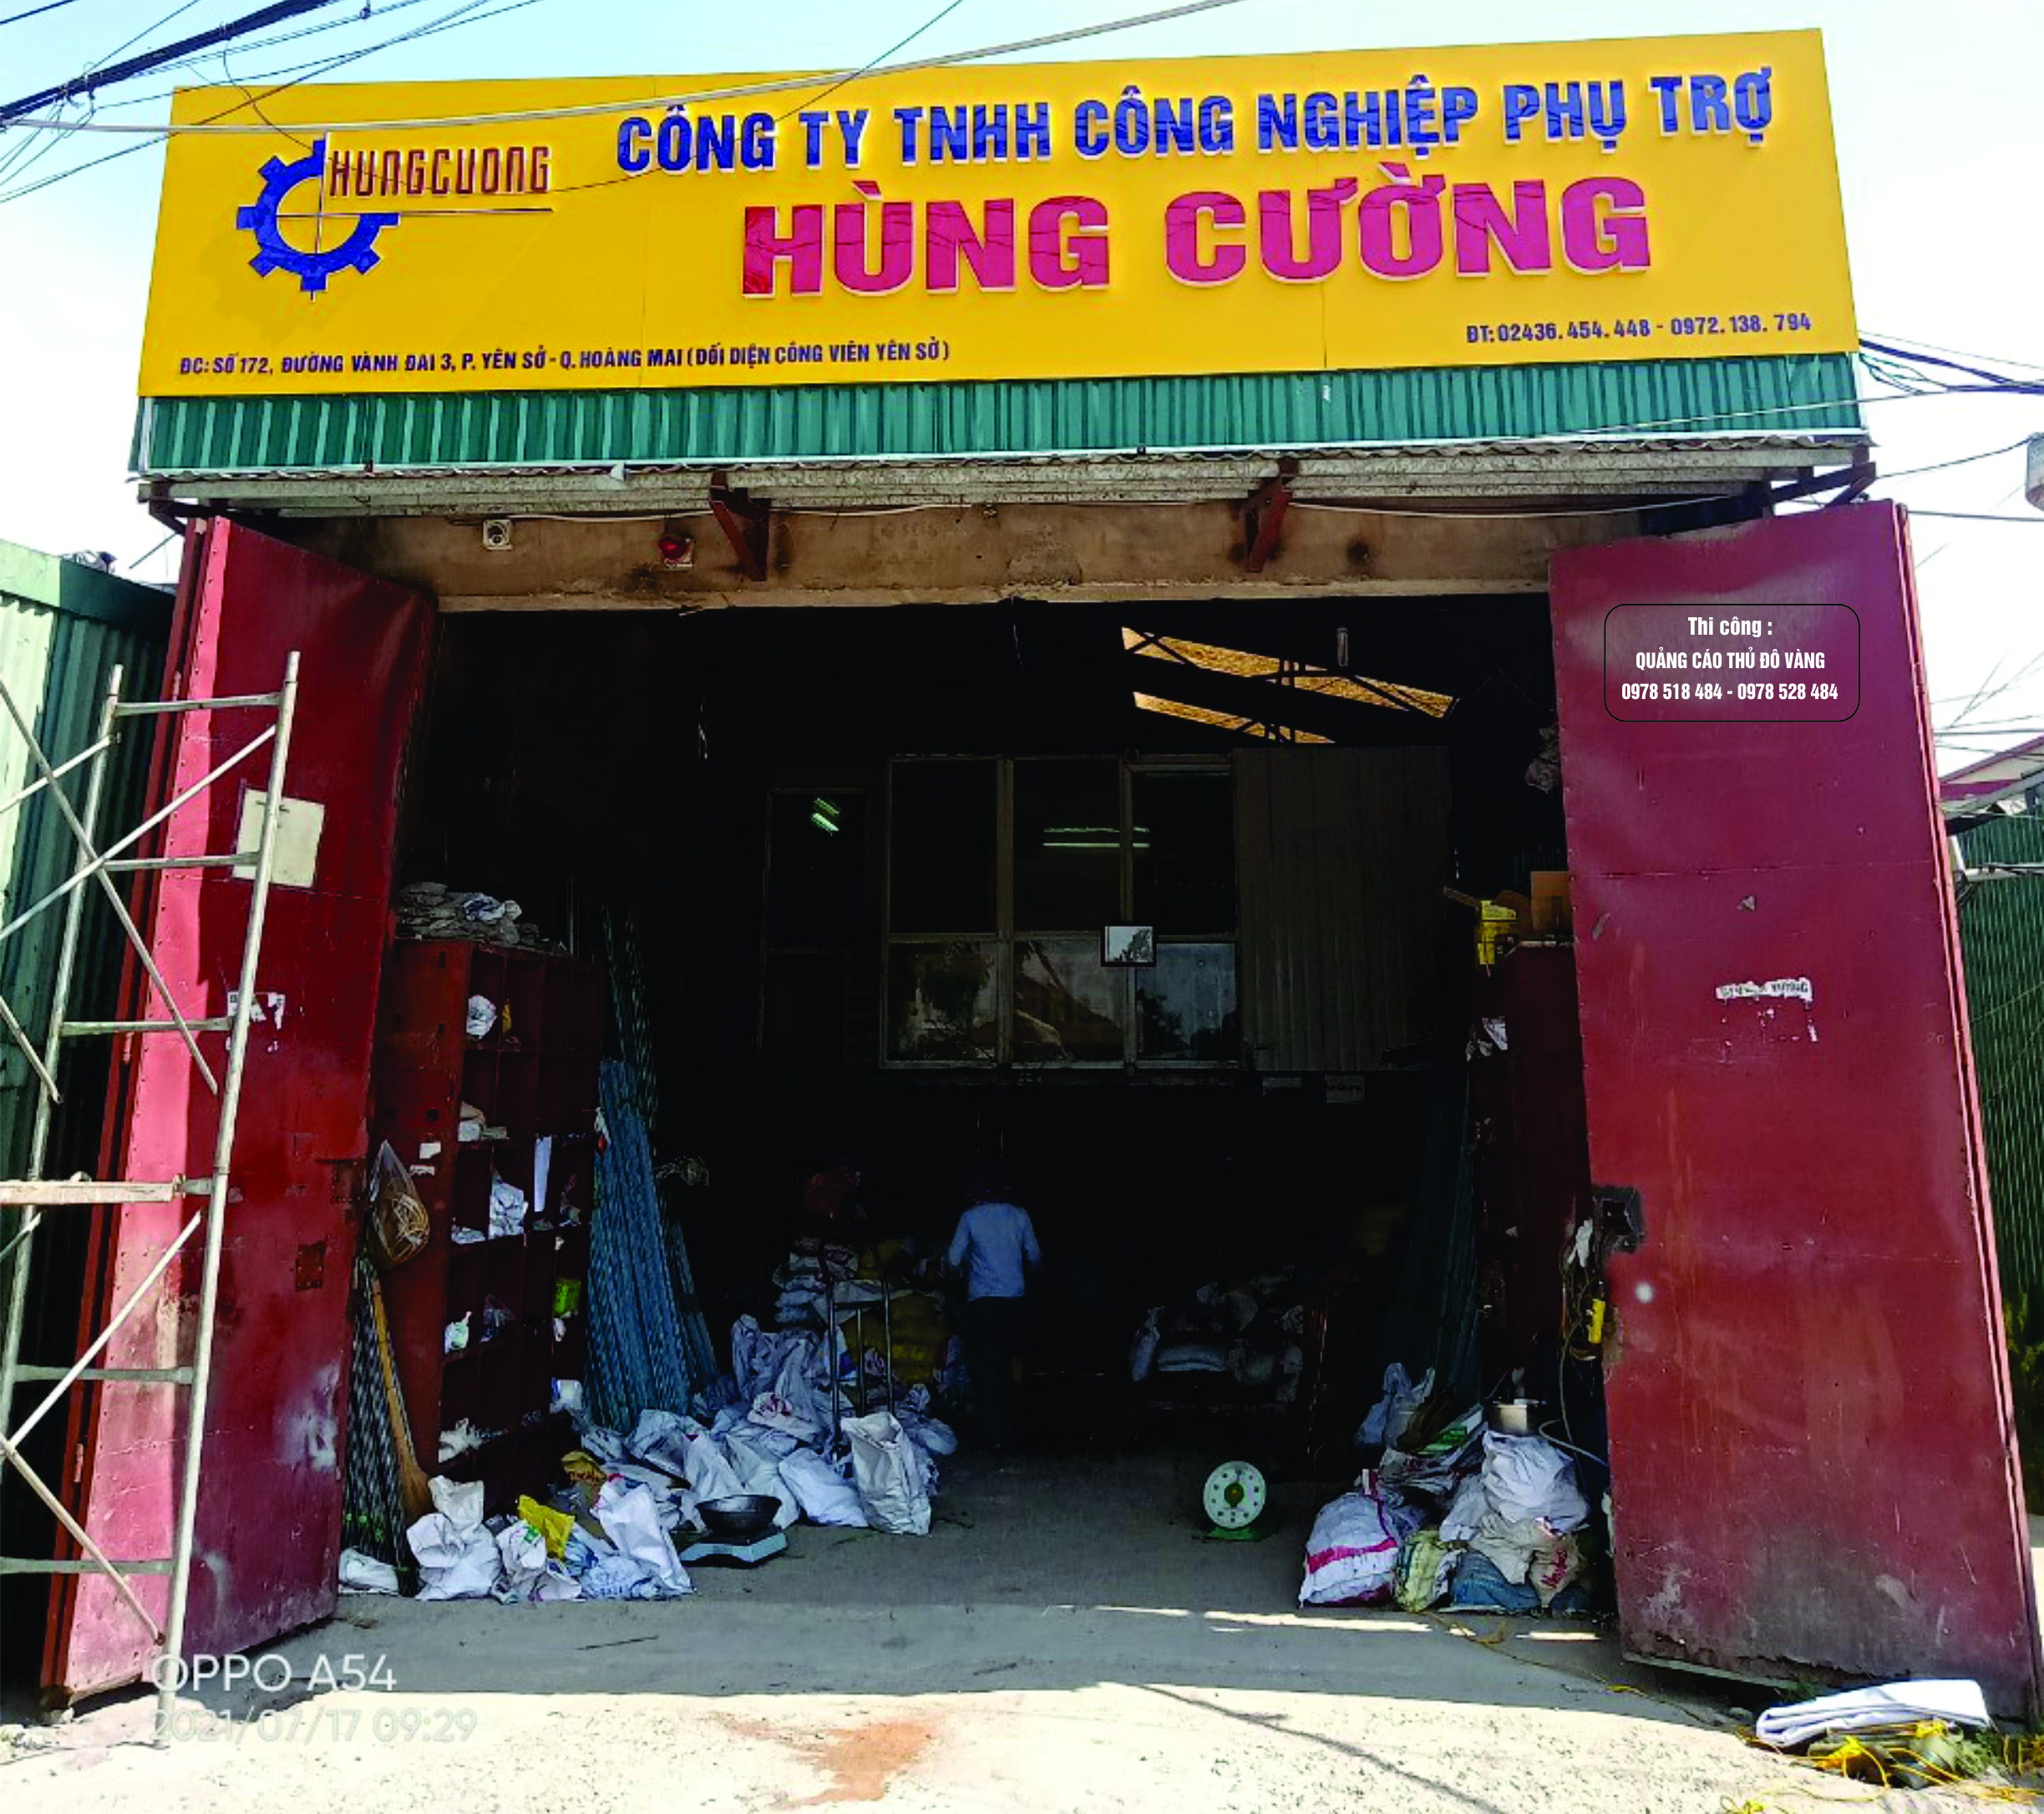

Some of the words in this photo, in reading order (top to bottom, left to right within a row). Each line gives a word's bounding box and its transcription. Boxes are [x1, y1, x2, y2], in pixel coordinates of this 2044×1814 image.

[617, 104, 777, 175] CÔNG
[799, 109, 870, 168] TY
[894, 102, 1052, 165] TNHH
[1073, 85, 1235, 159] CÔNG
[1256, 74, 1478, 160] NGHIỆP
[1504, 79, 1628, 152] PHỤ
[1649, 66, 1774, 145] TRỢ
[330, 146, 550, 196] HUNGCUONG
[743, 180, 1109, 298] HÙNG
[1165, 160, 1652, 288] CƯỜNG
[240, 357, 274, 375] 172,
[281, 351, 344, 373] ĐƯỜNG
[351, 351, 399, 372] VÀNH
[404, 354, 435, 372] ĐAI
[440, 353, 456, 372] 3,
[461, 352, 476, 370] P.
[482, 348, 517, 369] YÊN
[560, 350, 576, 370] Q.
[579, 347, 642, 368] HOÀNG
[647, 349, 682, 367] MAI
[774, 341, 824, 365] CÔNG
[829, 340, 870, 362] VIÊN
[875, 339, 910, 361] YÊN
